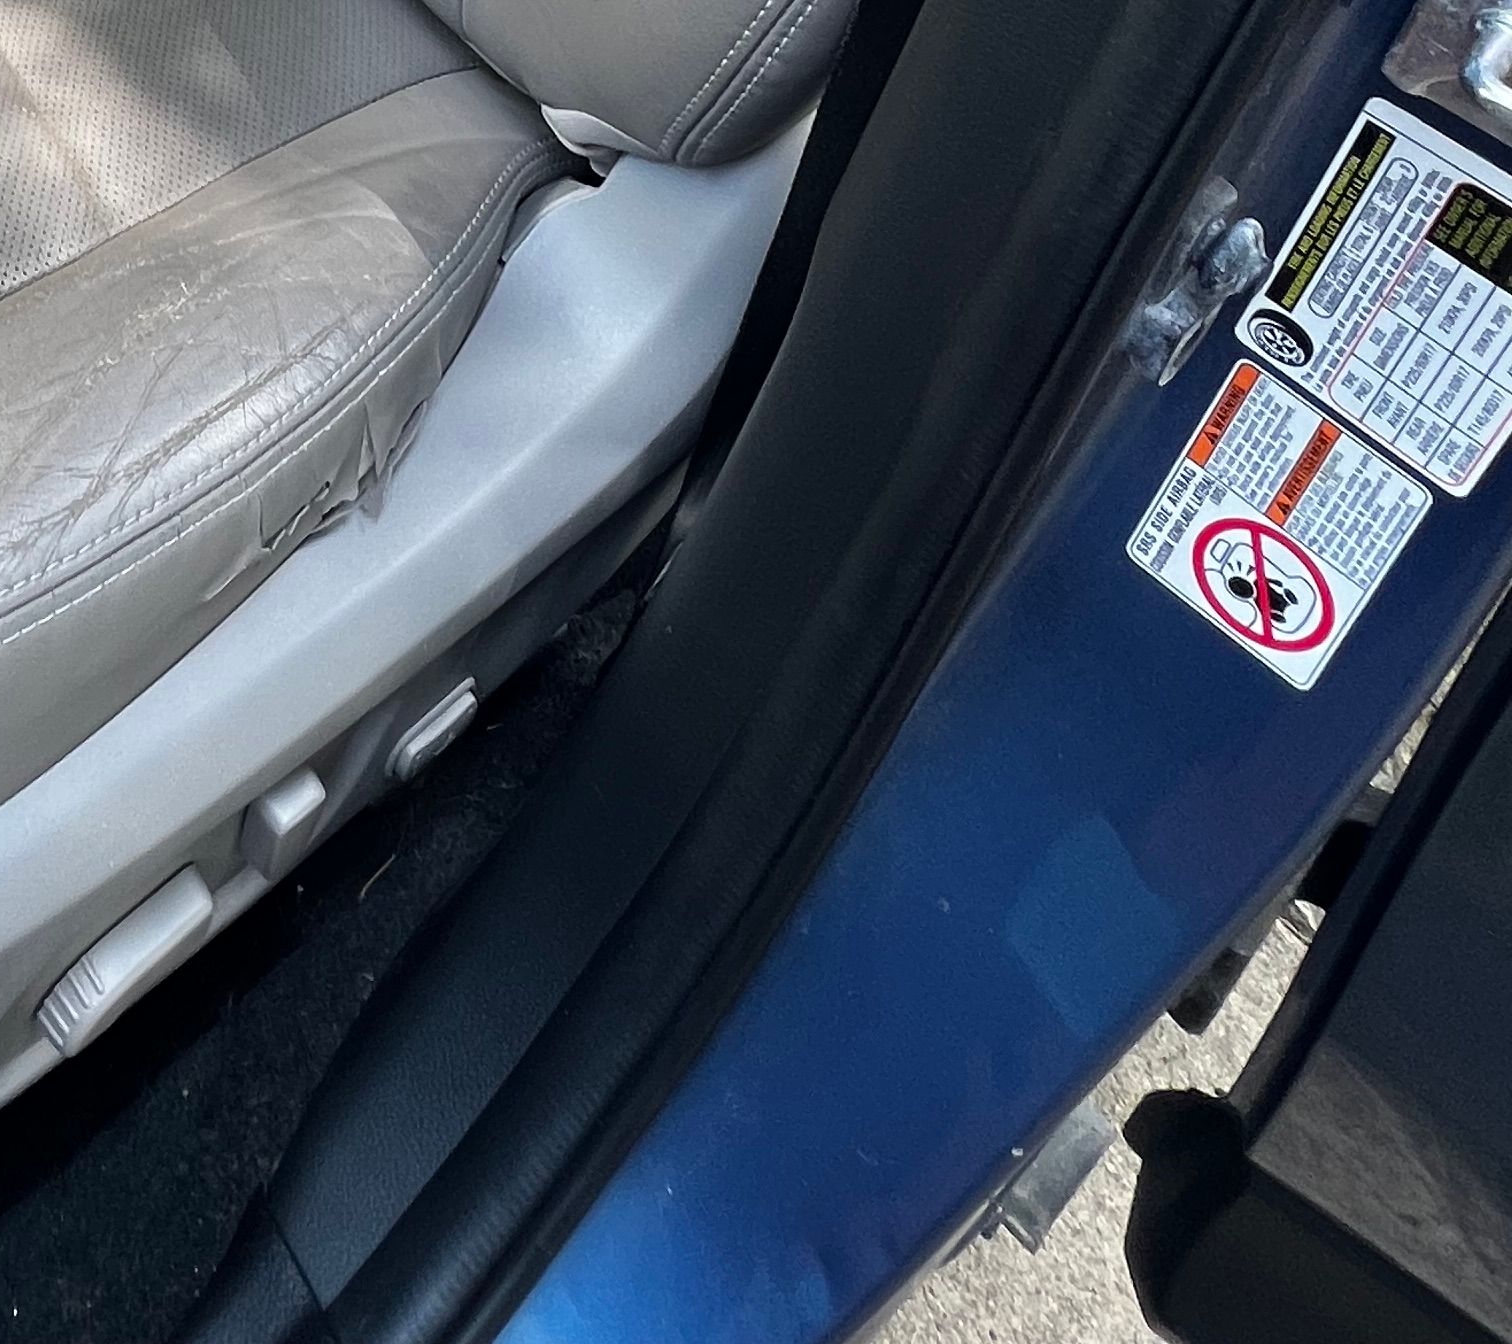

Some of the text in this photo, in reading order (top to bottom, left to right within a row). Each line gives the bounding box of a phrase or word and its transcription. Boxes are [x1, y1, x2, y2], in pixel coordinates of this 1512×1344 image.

[1210, 382, 1246, 431] WARNING
[1135, 463, 1197, 557] SRS SIDE AIRBAG
